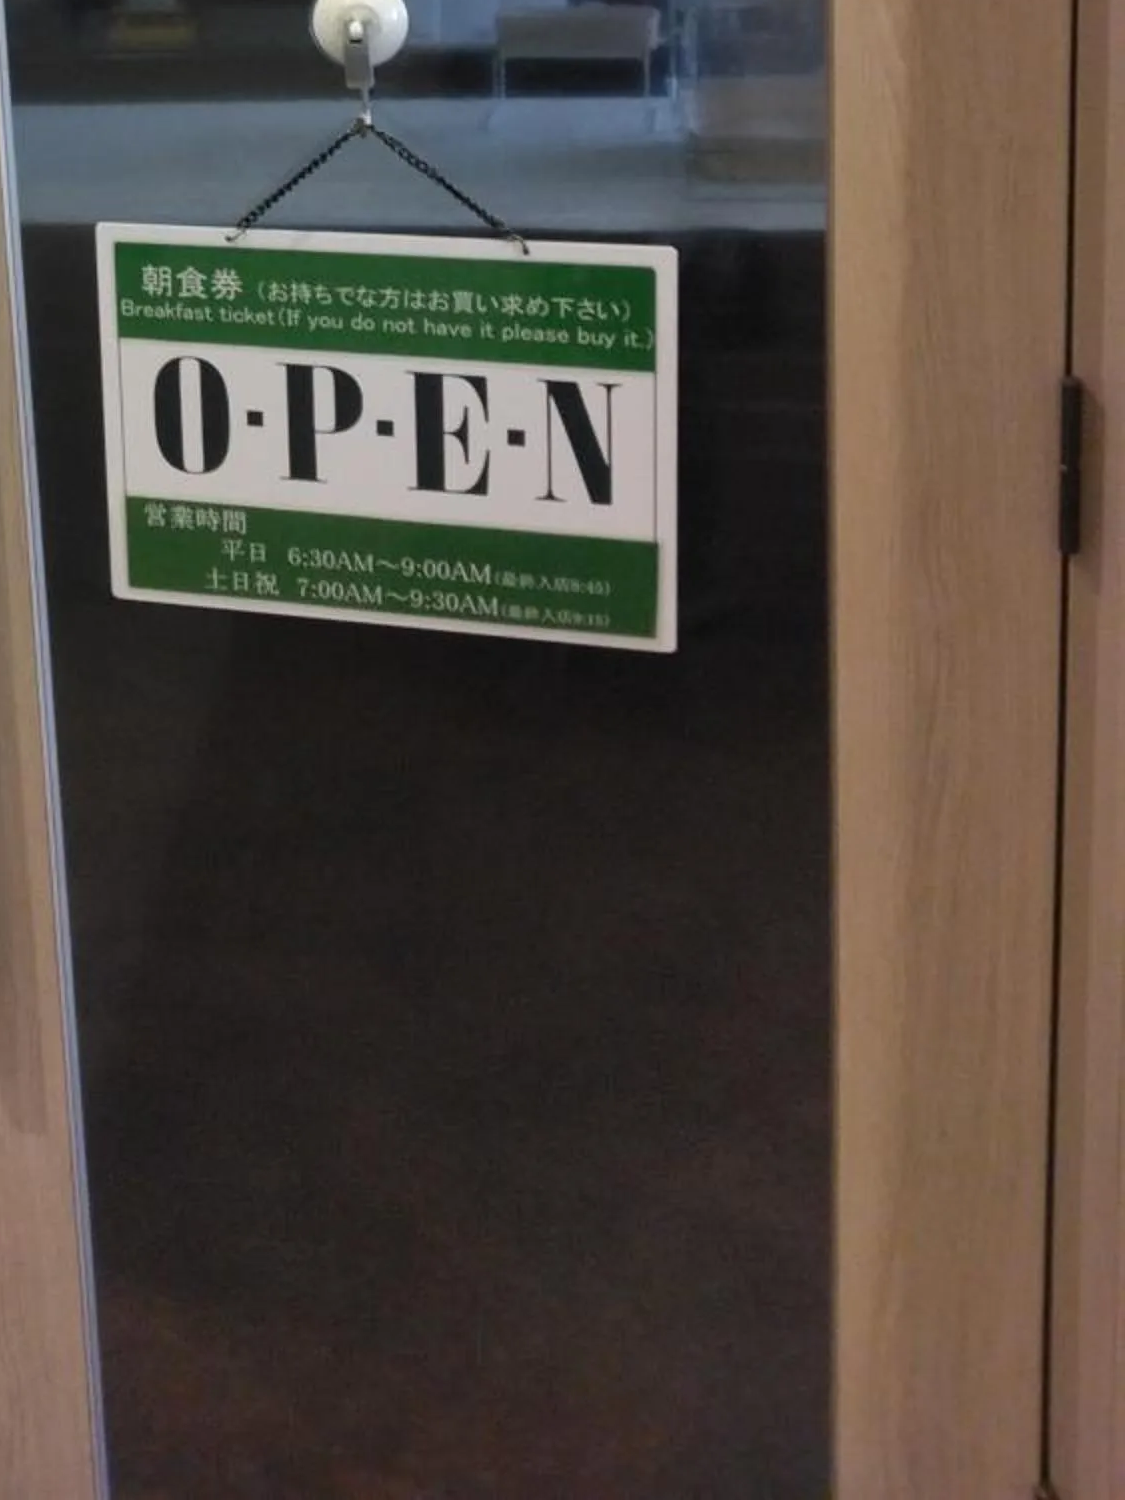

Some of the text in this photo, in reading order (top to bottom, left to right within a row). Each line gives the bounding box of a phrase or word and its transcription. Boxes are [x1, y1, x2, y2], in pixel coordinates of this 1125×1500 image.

[141, 264, 244, 301] 朝食券
[121, 299, 214, 323] Breakfast
[308, 314, 344, 332] you
[351, 313, 376, 332] do
[382, 317, 416, 335] not
[424, 318, 473, 339] have
[480, 321, 496, 340] it
[501, 323, 571, 344] please
[577, 326, 616, 350] buy
[143, 502, 248, 536] 営業時間
[222, 538, 267, 564] 平日
[204, 565, 281, 597] 土日祝
